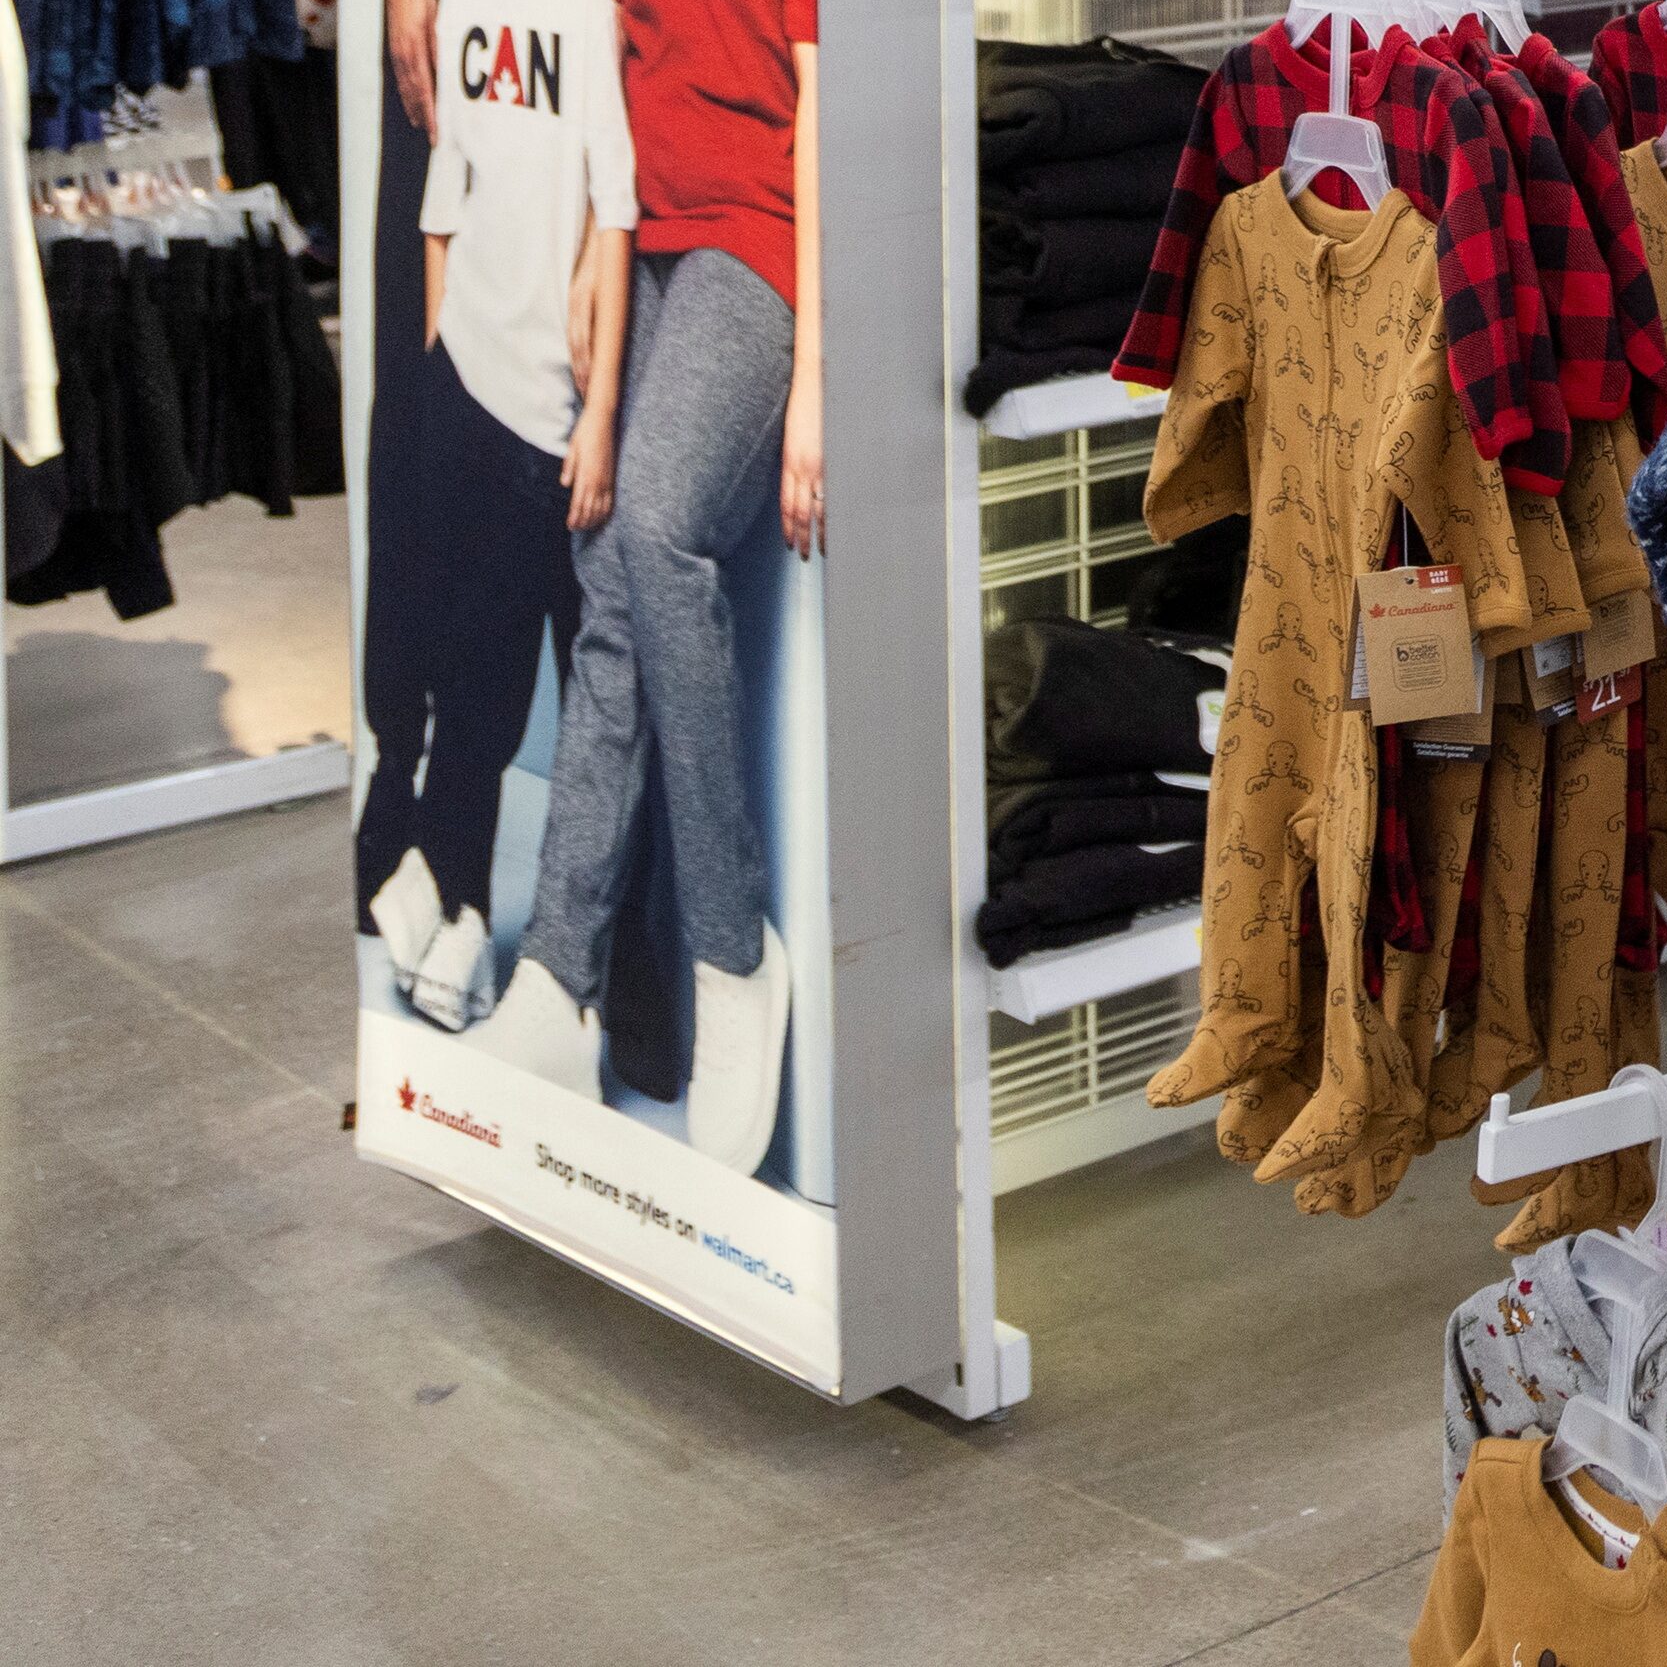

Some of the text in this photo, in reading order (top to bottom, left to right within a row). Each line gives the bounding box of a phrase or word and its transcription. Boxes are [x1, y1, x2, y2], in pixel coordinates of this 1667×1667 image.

[460, 23, 563, 116] CAN
[1388, 602, 1456, 617] Canadiana
[420, 1094, 503, 1148] Canadiana
[535, 1142, 795, 1295] Shop more styles on walmart.ca
